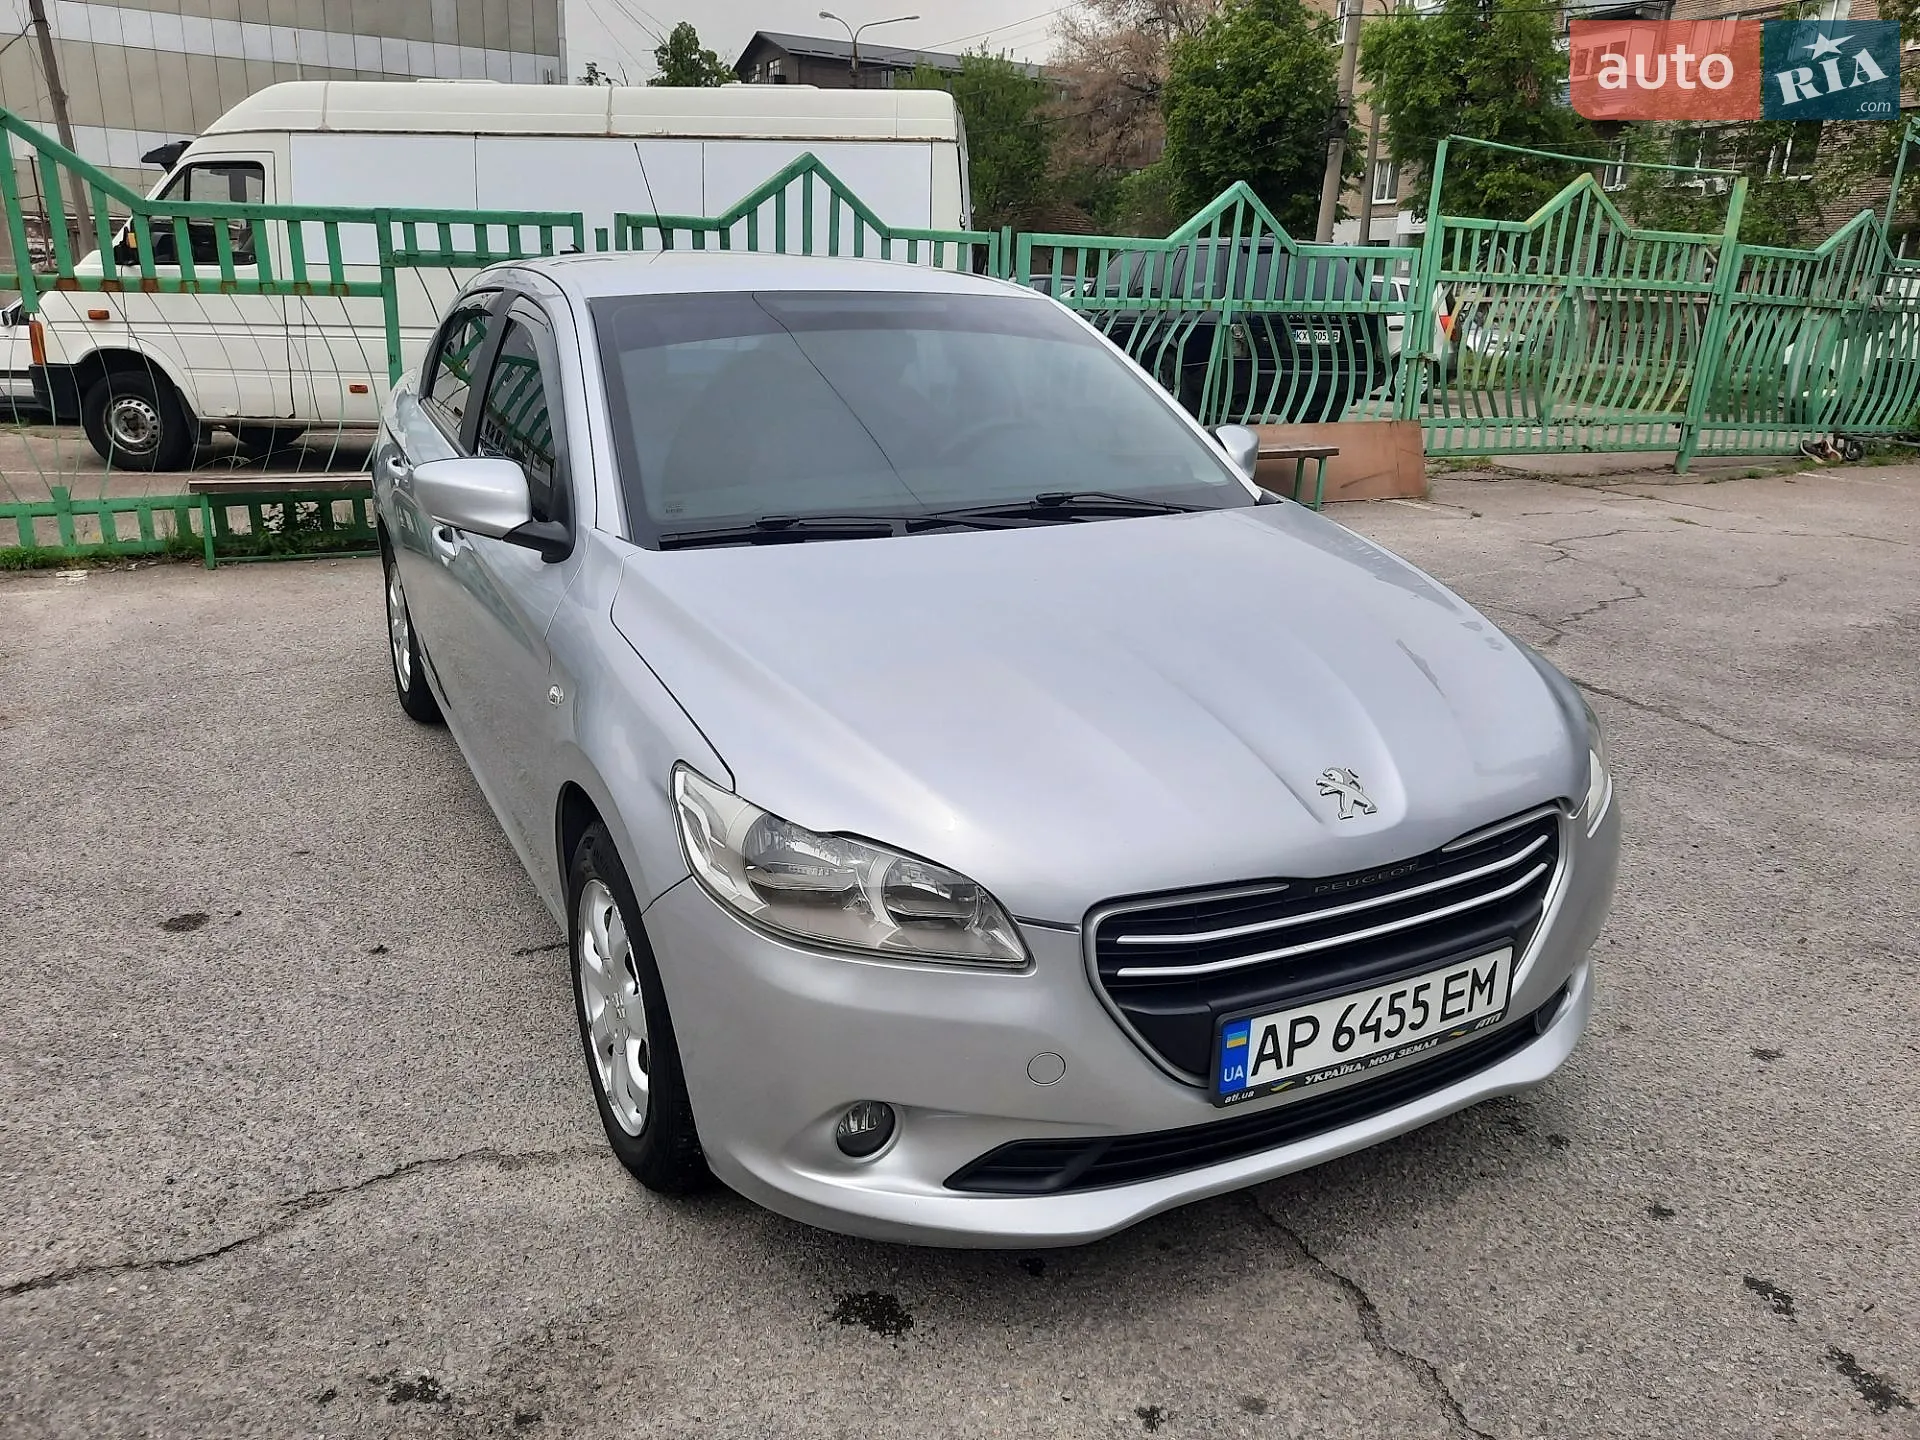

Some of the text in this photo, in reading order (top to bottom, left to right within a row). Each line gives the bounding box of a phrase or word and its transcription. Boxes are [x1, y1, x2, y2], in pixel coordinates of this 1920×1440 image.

[1314, 863, 1417, 893] PEUGEOT
[1250, 960, 1498, 1076] AP 6455 EM
[1224, 1064, 1244, 1082] UA
[1304, 1038, 1439, 1085] УКРАЇНА, МОЯ ЗЕМЛЯ
